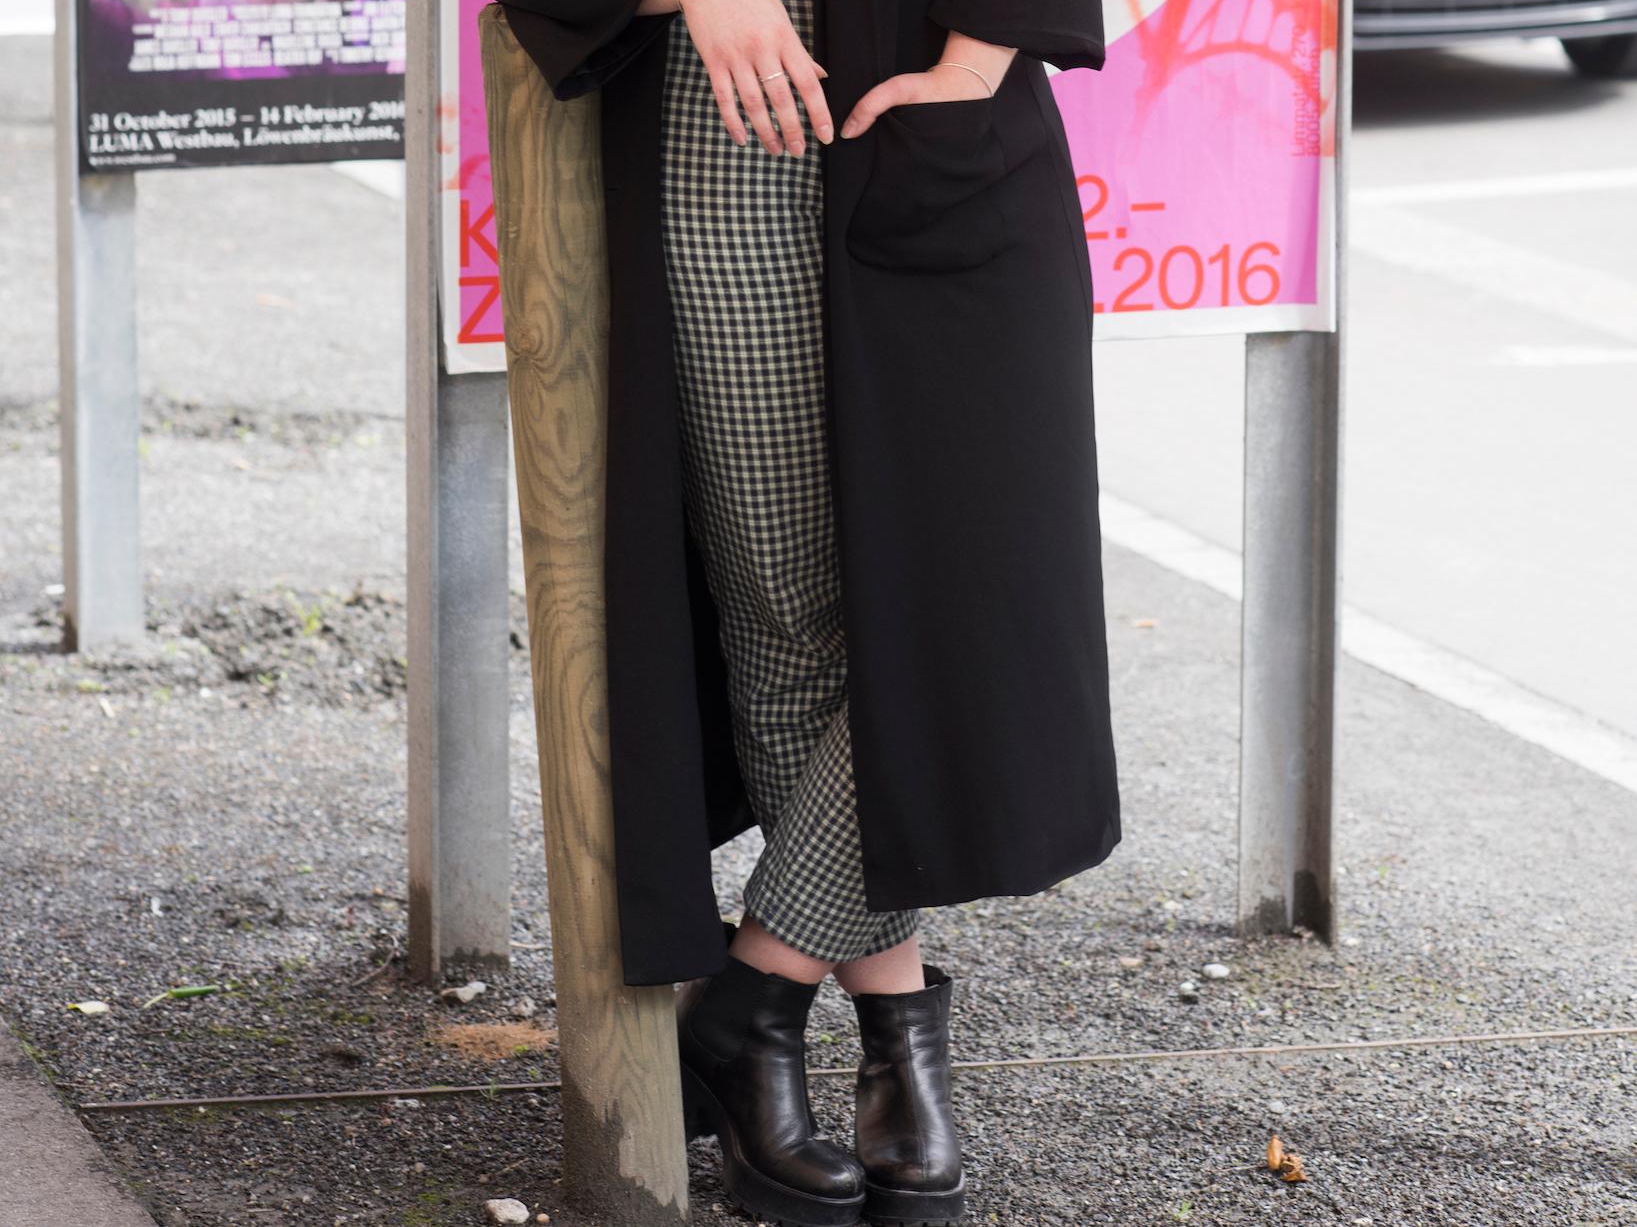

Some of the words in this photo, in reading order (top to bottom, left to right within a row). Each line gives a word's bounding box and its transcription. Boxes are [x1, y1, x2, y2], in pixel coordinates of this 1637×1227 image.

[89, 112, 109, 132] 31
[113, 110, 191, 131] October
[194, 107, 236, 128] 2015
[284, 103, 365, 125] February
[90, 131, 153, 153] LUMA
[156, 129, 240, 150] Westbau,
